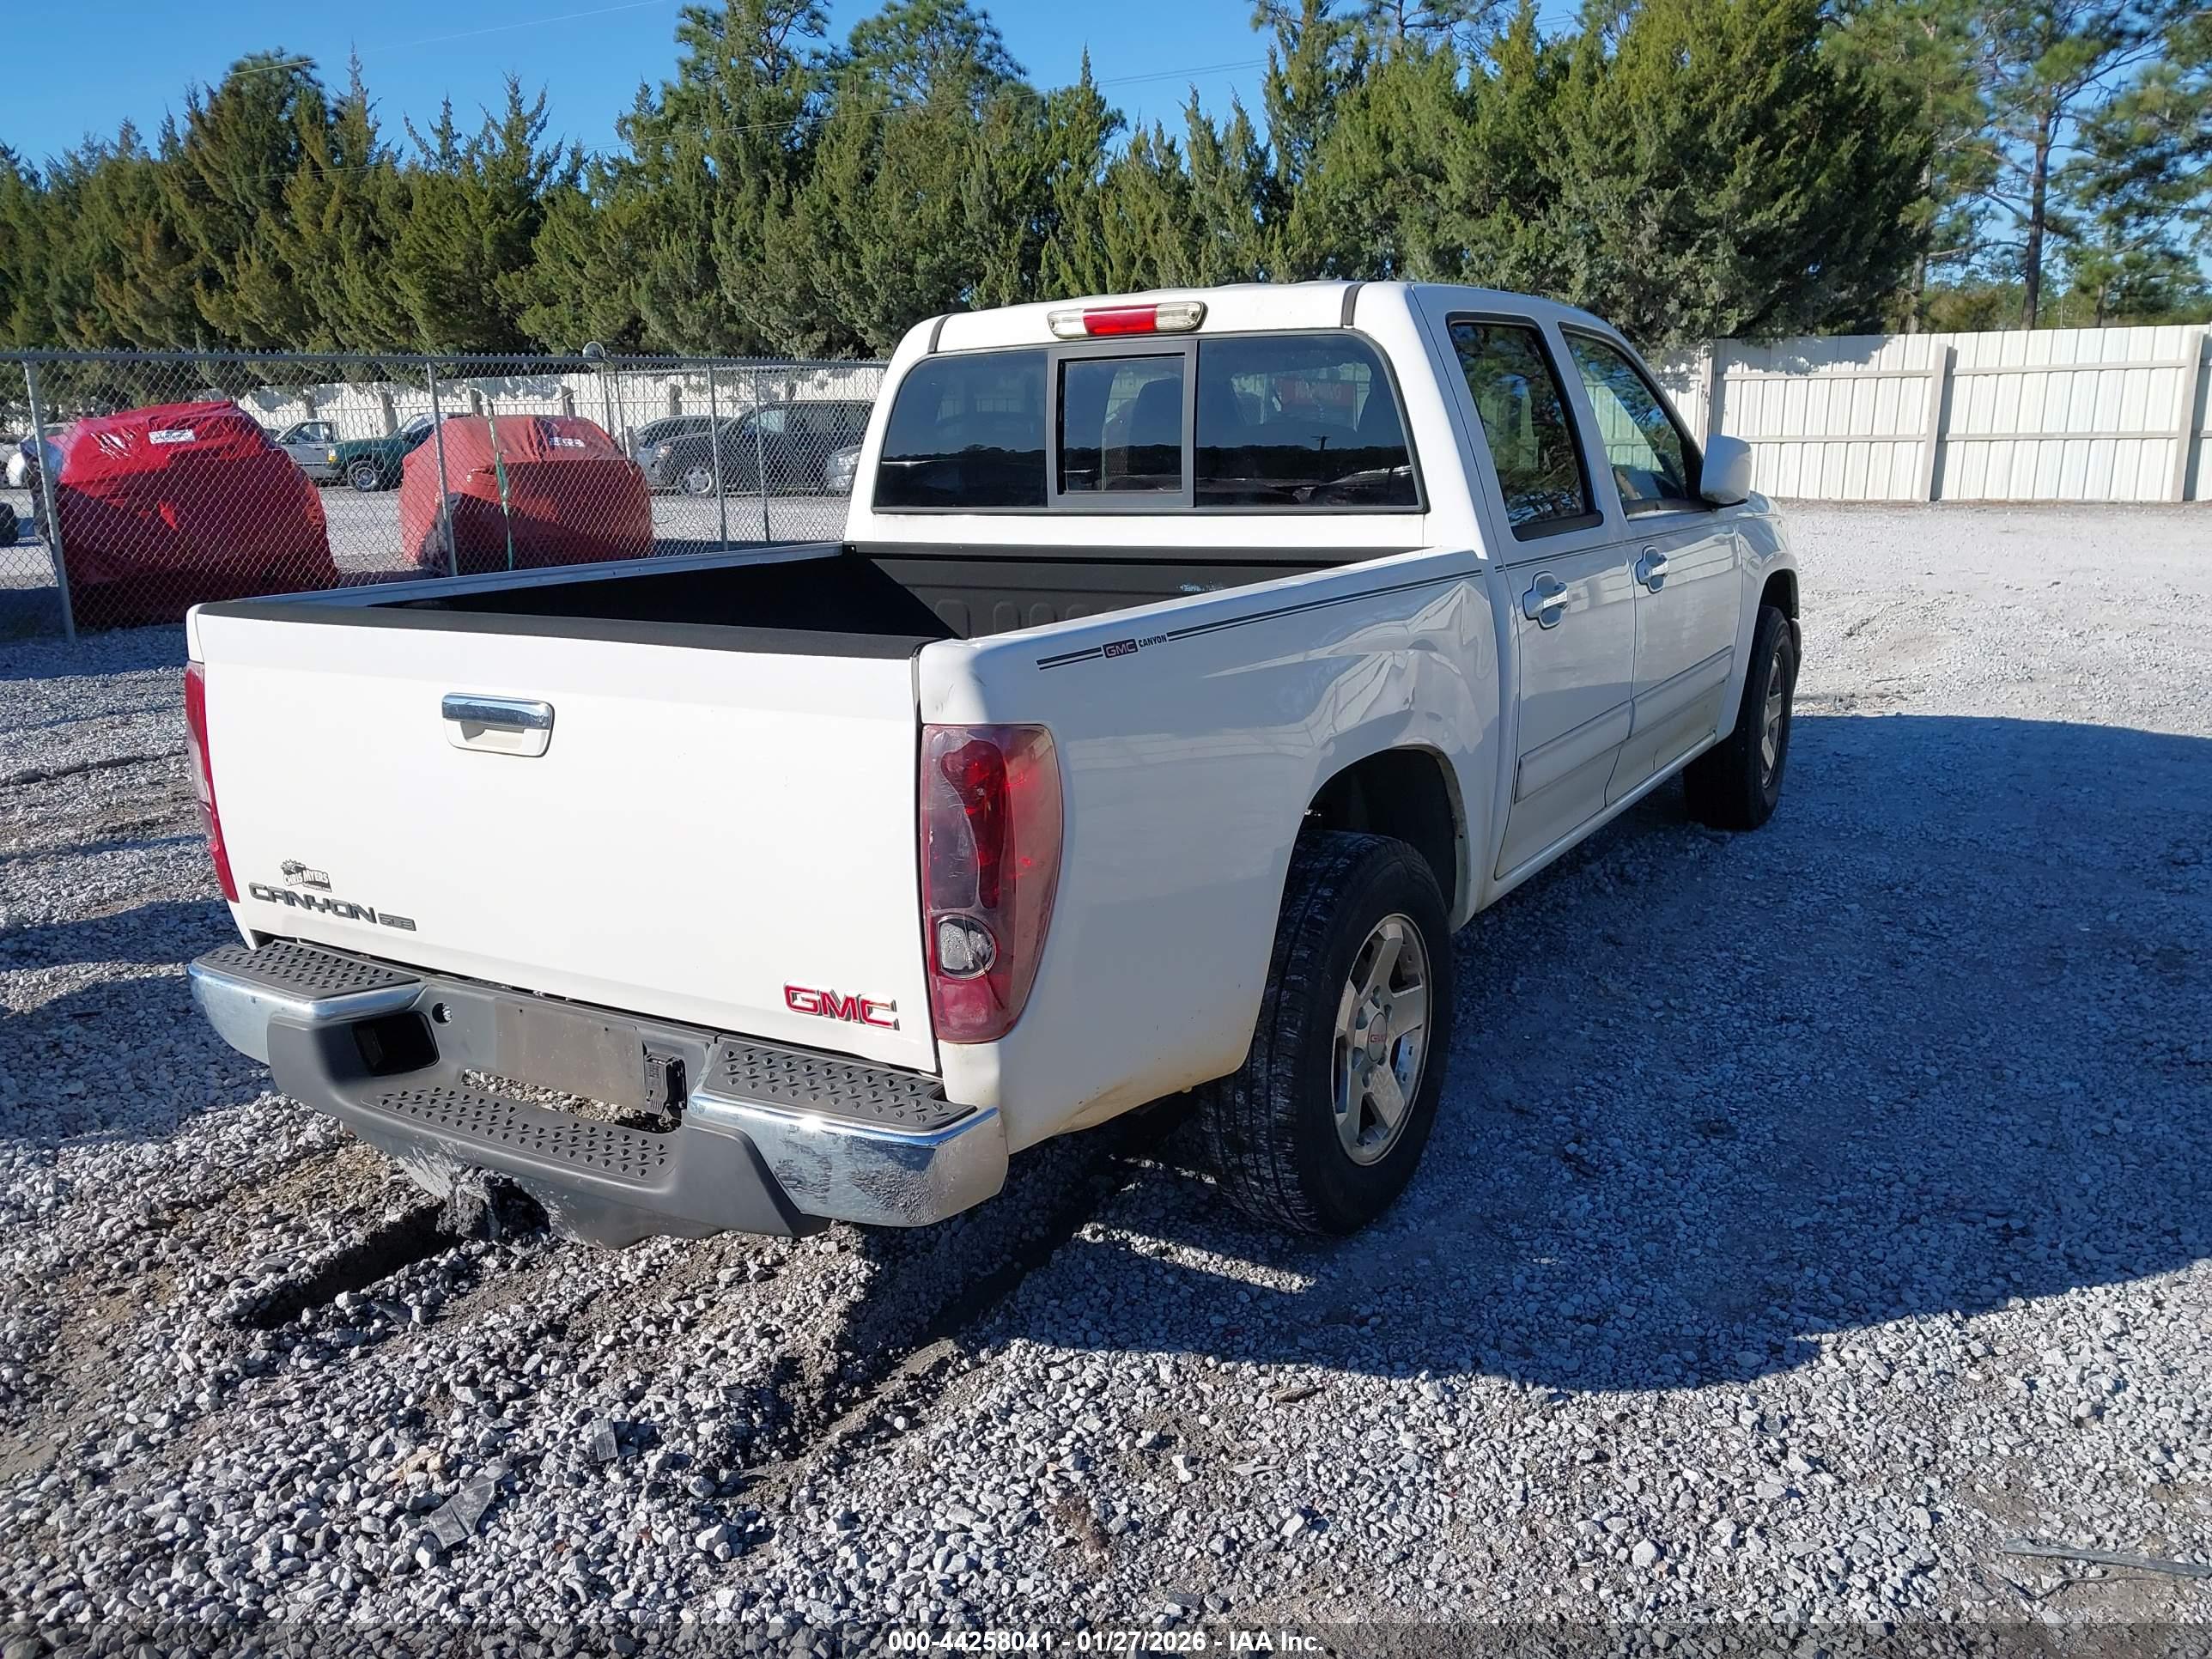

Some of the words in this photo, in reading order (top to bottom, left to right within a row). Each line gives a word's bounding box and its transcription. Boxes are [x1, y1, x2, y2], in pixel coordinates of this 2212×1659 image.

[1106, 642, 1136, 657] GMC
[1138, 635, 1167, 647] CANYON
[283, 872, 303, 885] CHRIS
[303, 869, 328, 884] MYERS
[248, 882, 377, 924] CANYON
[784, 981, 900, 1030] GMC
